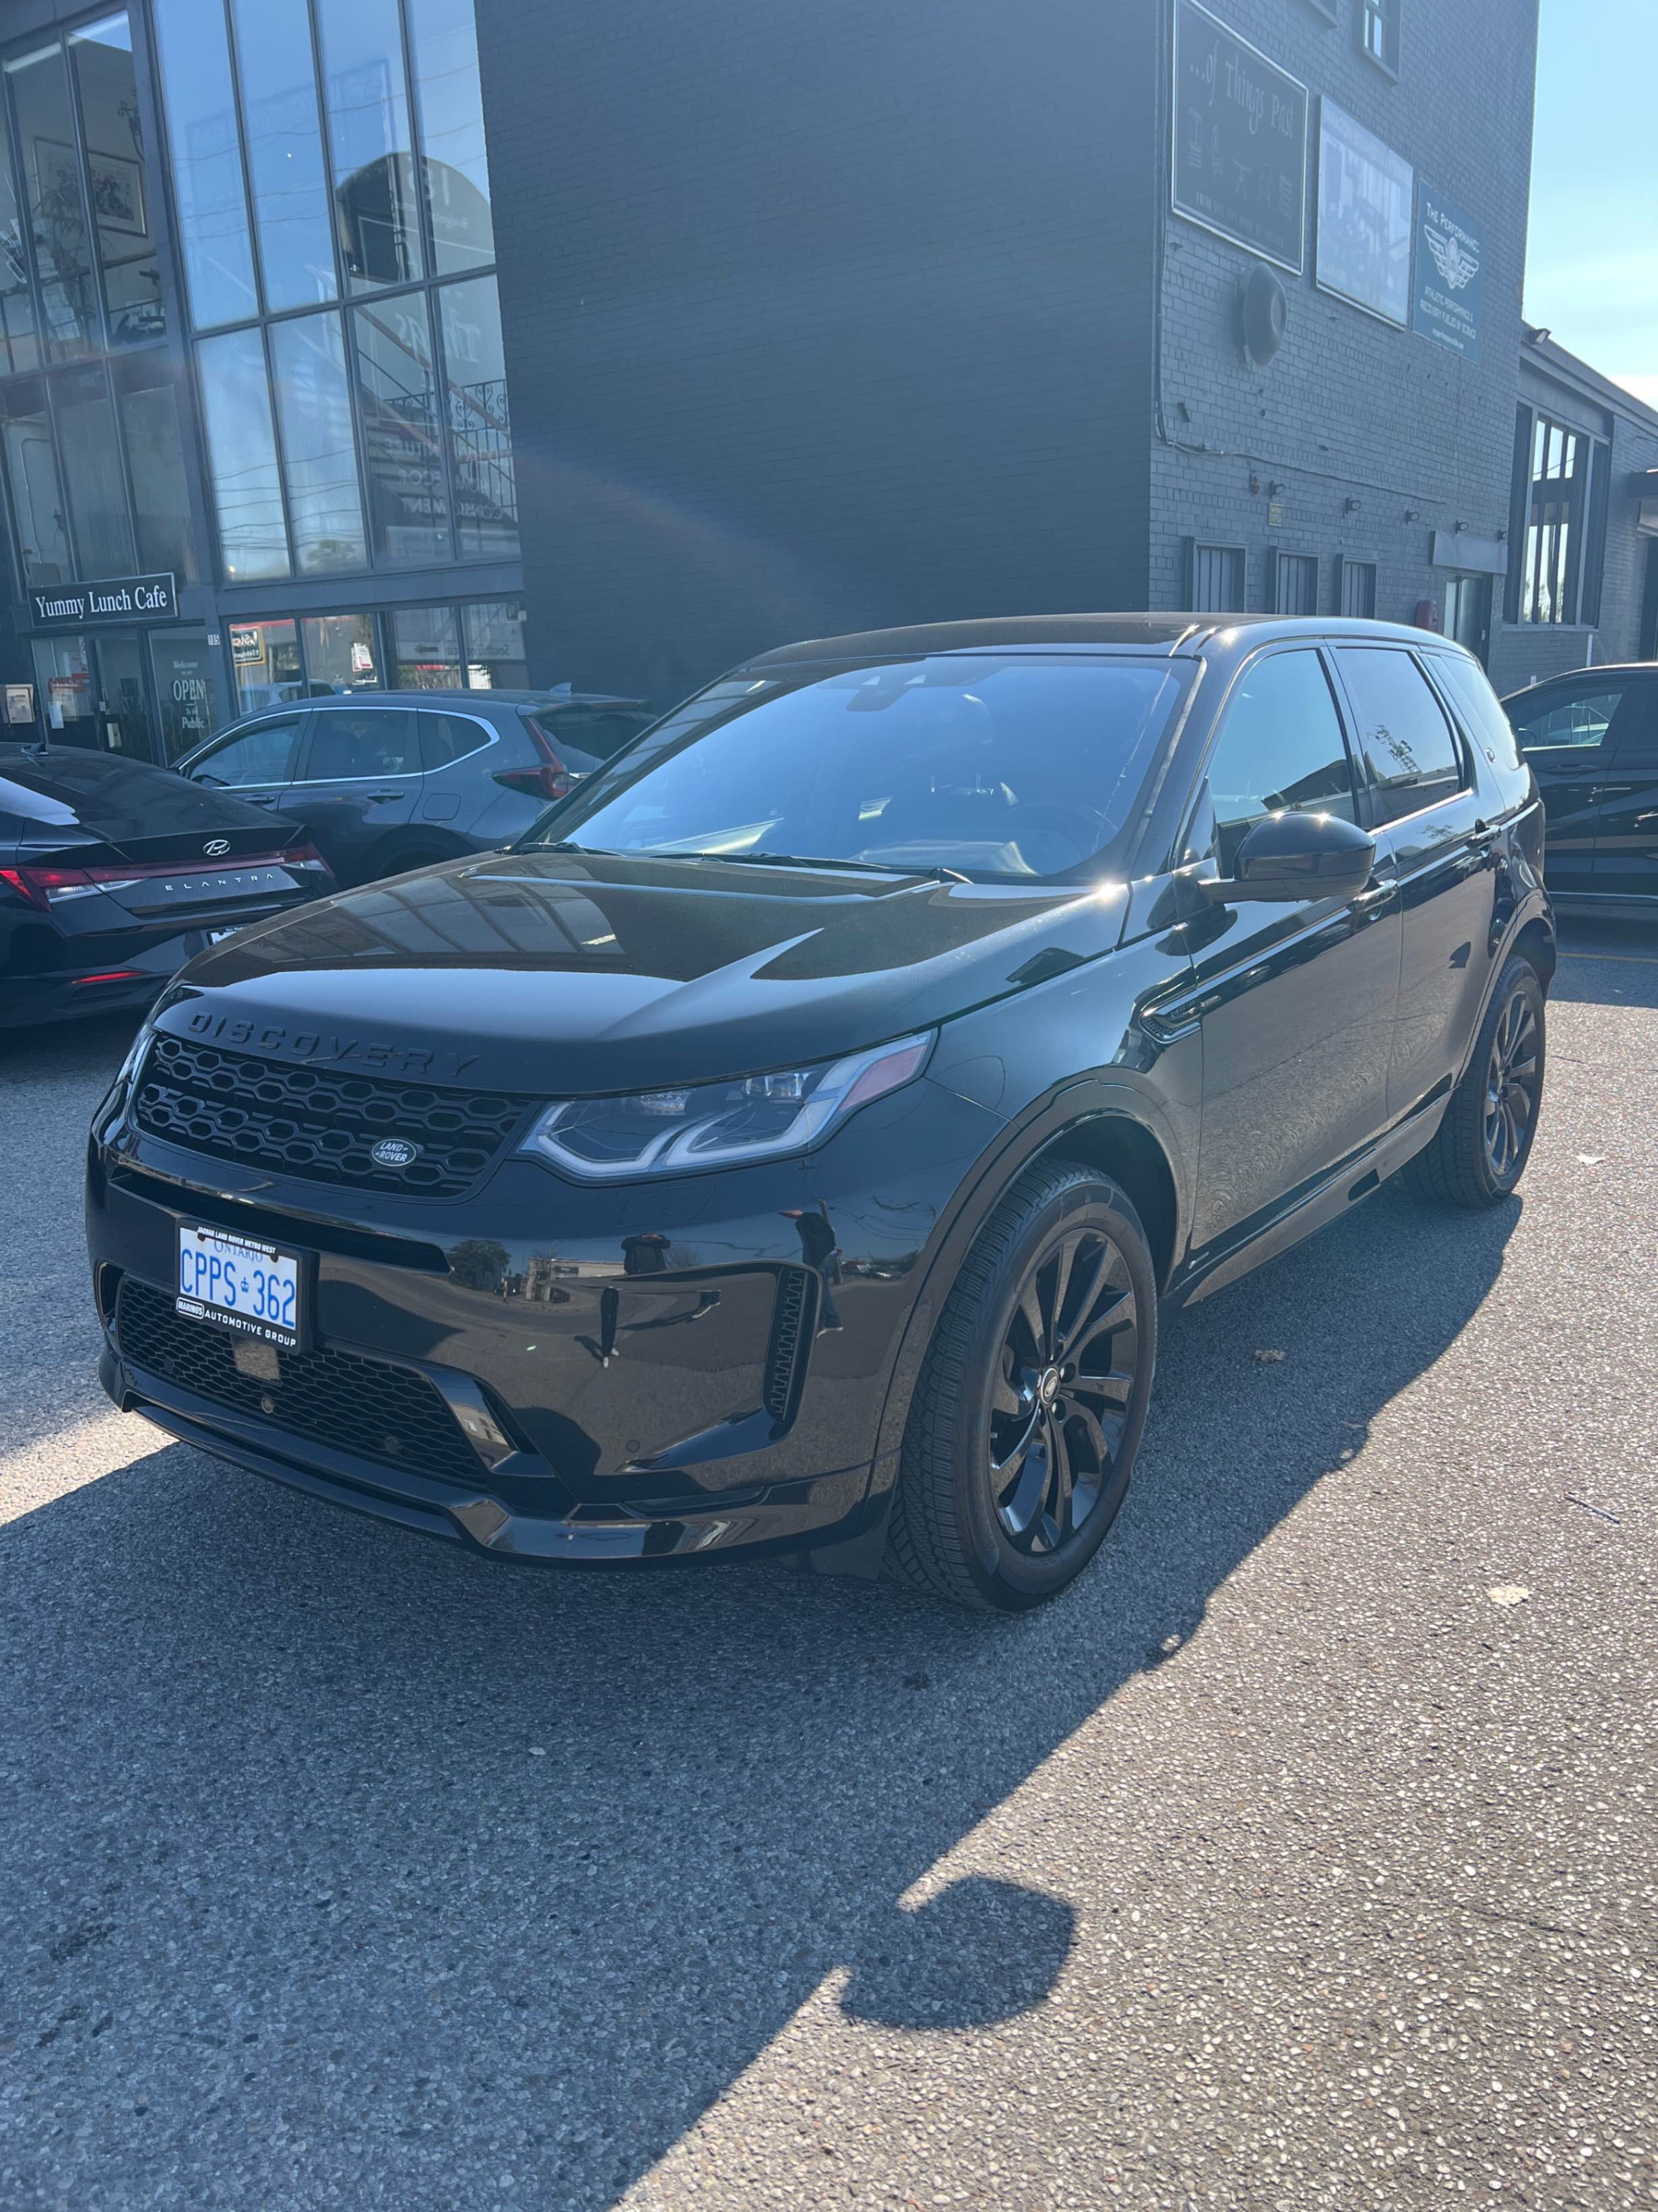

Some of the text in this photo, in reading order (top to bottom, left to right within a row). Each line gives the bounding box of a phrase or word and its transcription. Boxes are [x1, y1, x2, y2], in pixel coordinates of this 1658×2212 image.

[1225, 54, 1265, 135] Things
[1271, 92, 1294, 138] Past
[35, 585, 167, 619] Yummy Lunch Cafe
[173, 660, 198, 668] Welcome
[173, 679, 205, 701] OPEN
[182, 716, 205, 728] Public
[164, 873, 274, 891] ELANTRA
[188, 1011, 482, 1077] DISCOVERY
[379, 1142, 404, 1152] LAND
[379, 1150, 408, 1162] ROVER
[216, 1231, 228, 1241] LAND
[228, 1234, 244, 1245] ROVER
[244, 1239, 261, 1250] METRO
[261, 1244, 276, 1254] WEST
[181, 1249, 295, 1327] CPPS 362
[204, 1309, 262, 1335] AUTOMOTIVE
[265, 1330, 296, 1347] GROUP
